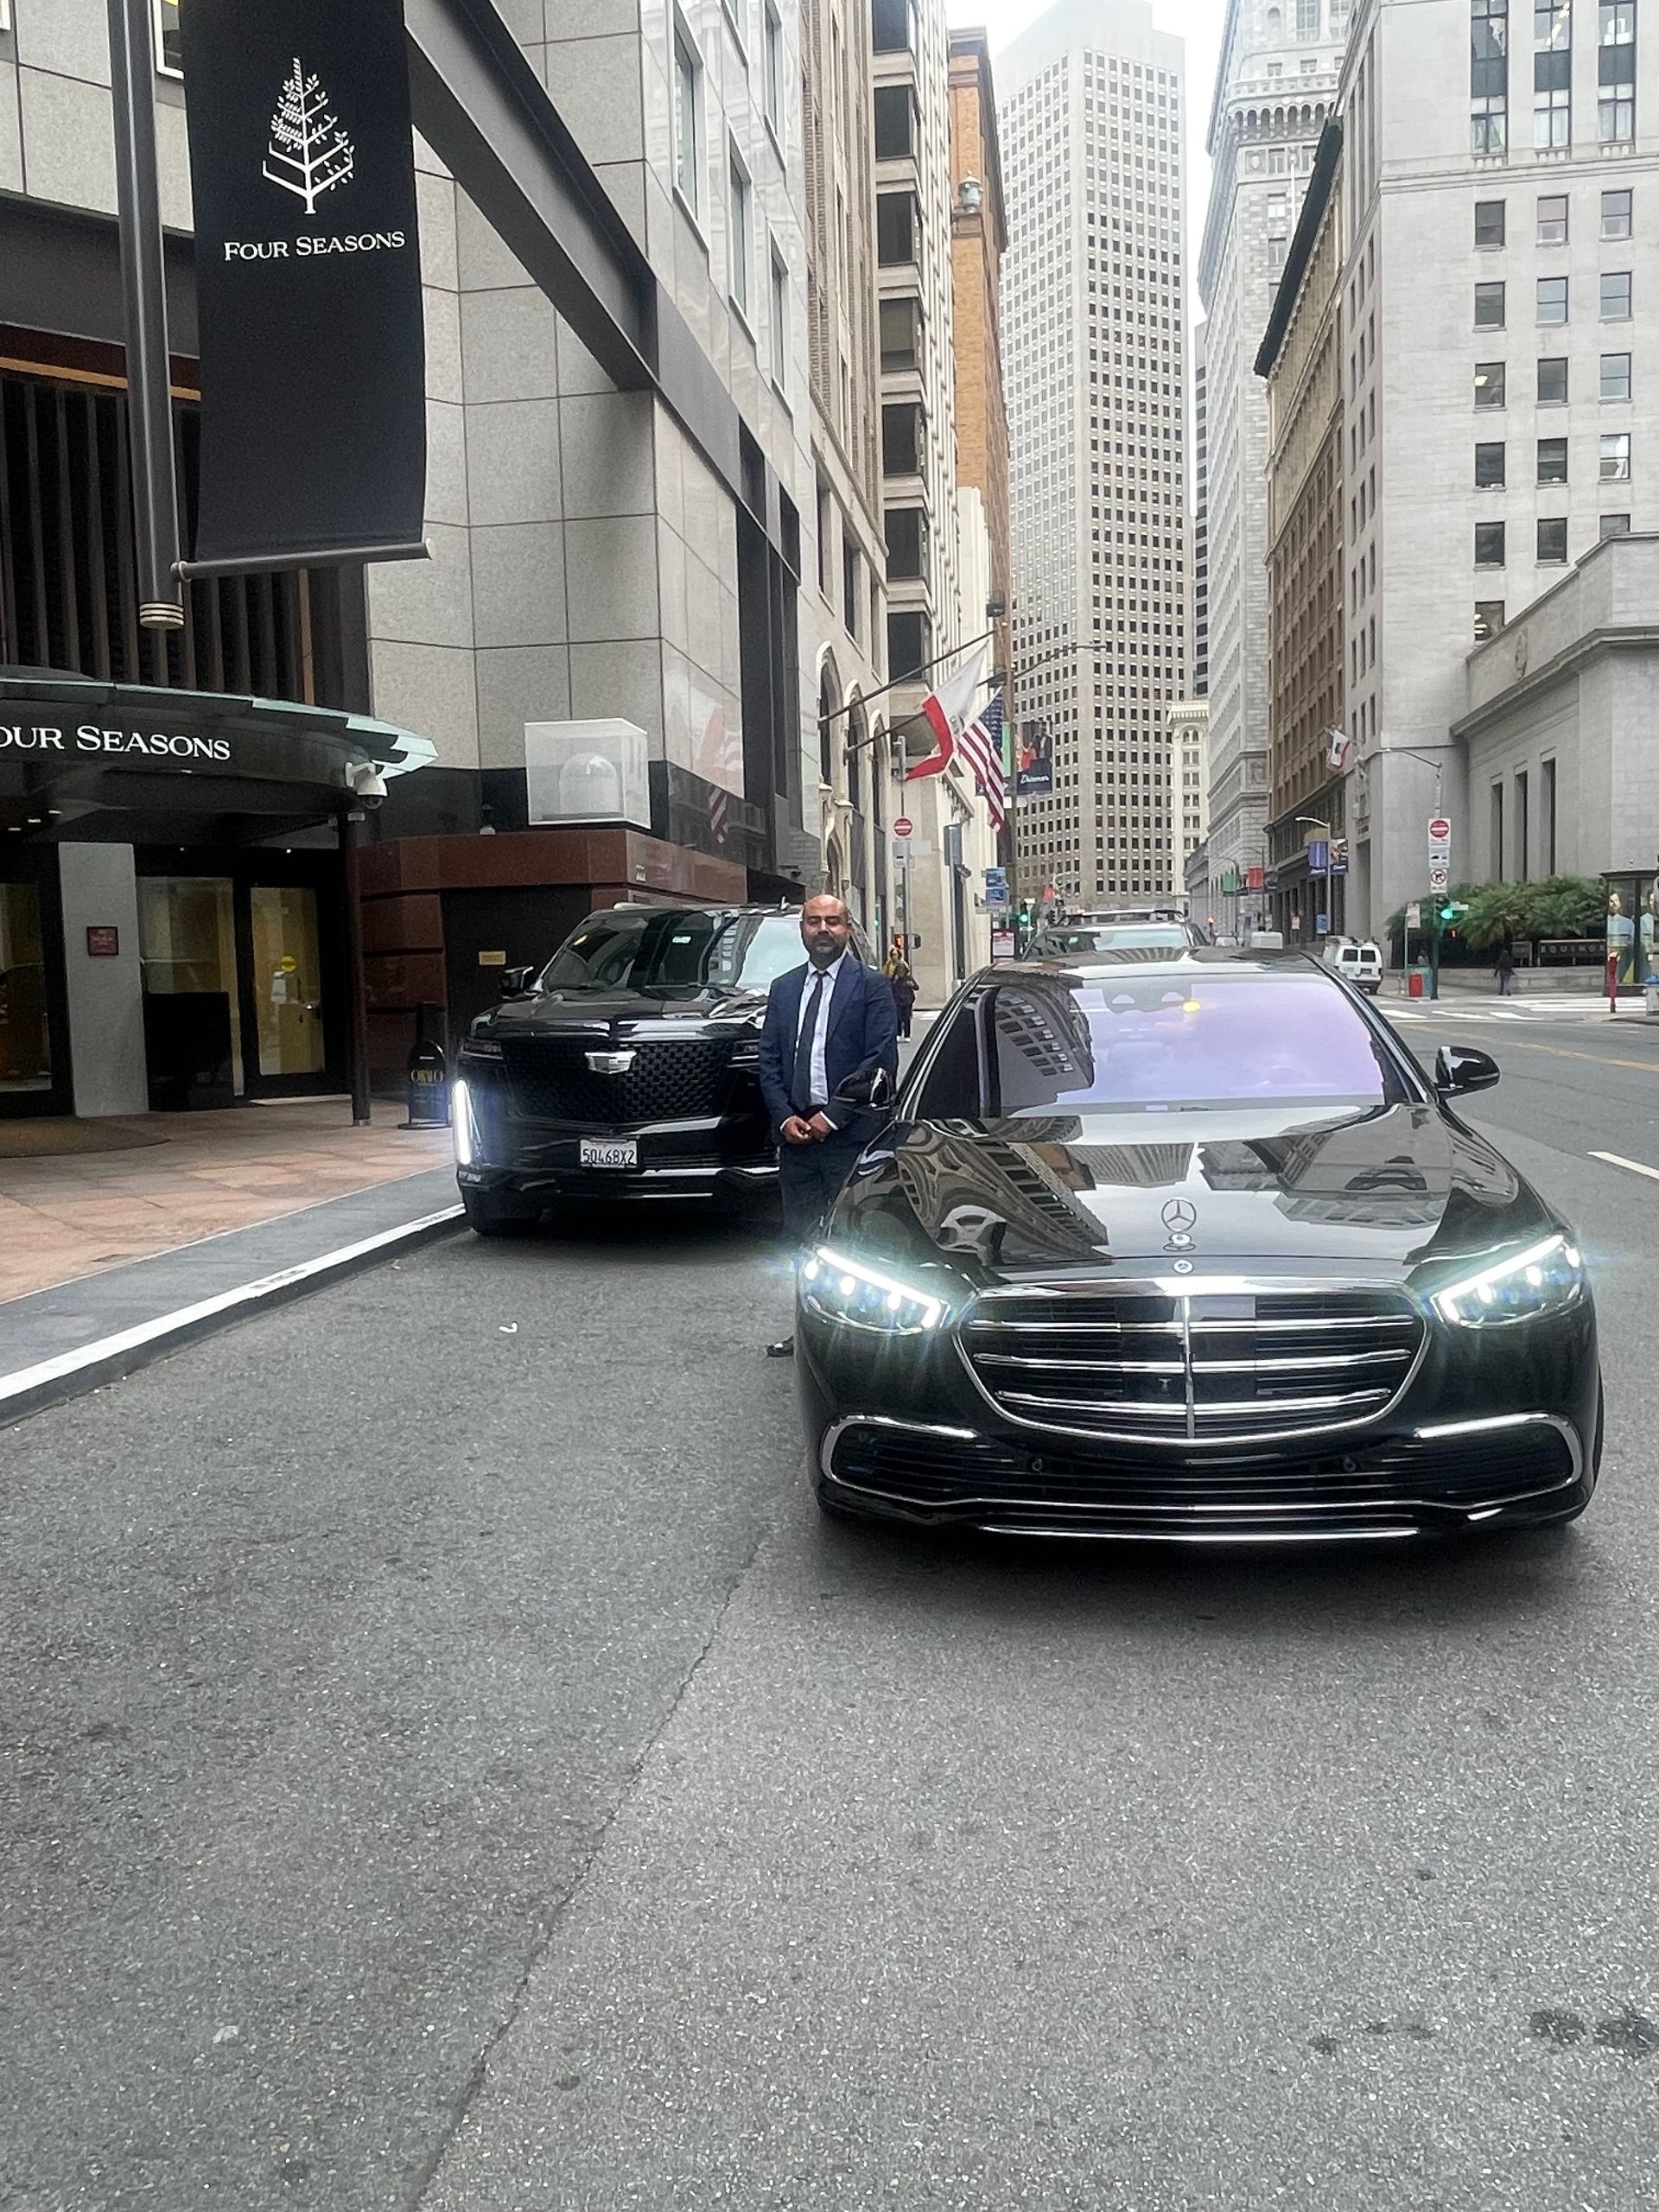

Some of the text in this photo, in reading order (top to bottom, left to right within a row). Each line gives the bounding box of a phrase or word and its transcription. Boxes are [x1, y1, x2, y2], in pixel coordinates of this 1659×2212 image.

[223, 231, 405, 261] FOUR SEASONS
[76, 725, 231, 760] SEASONS
